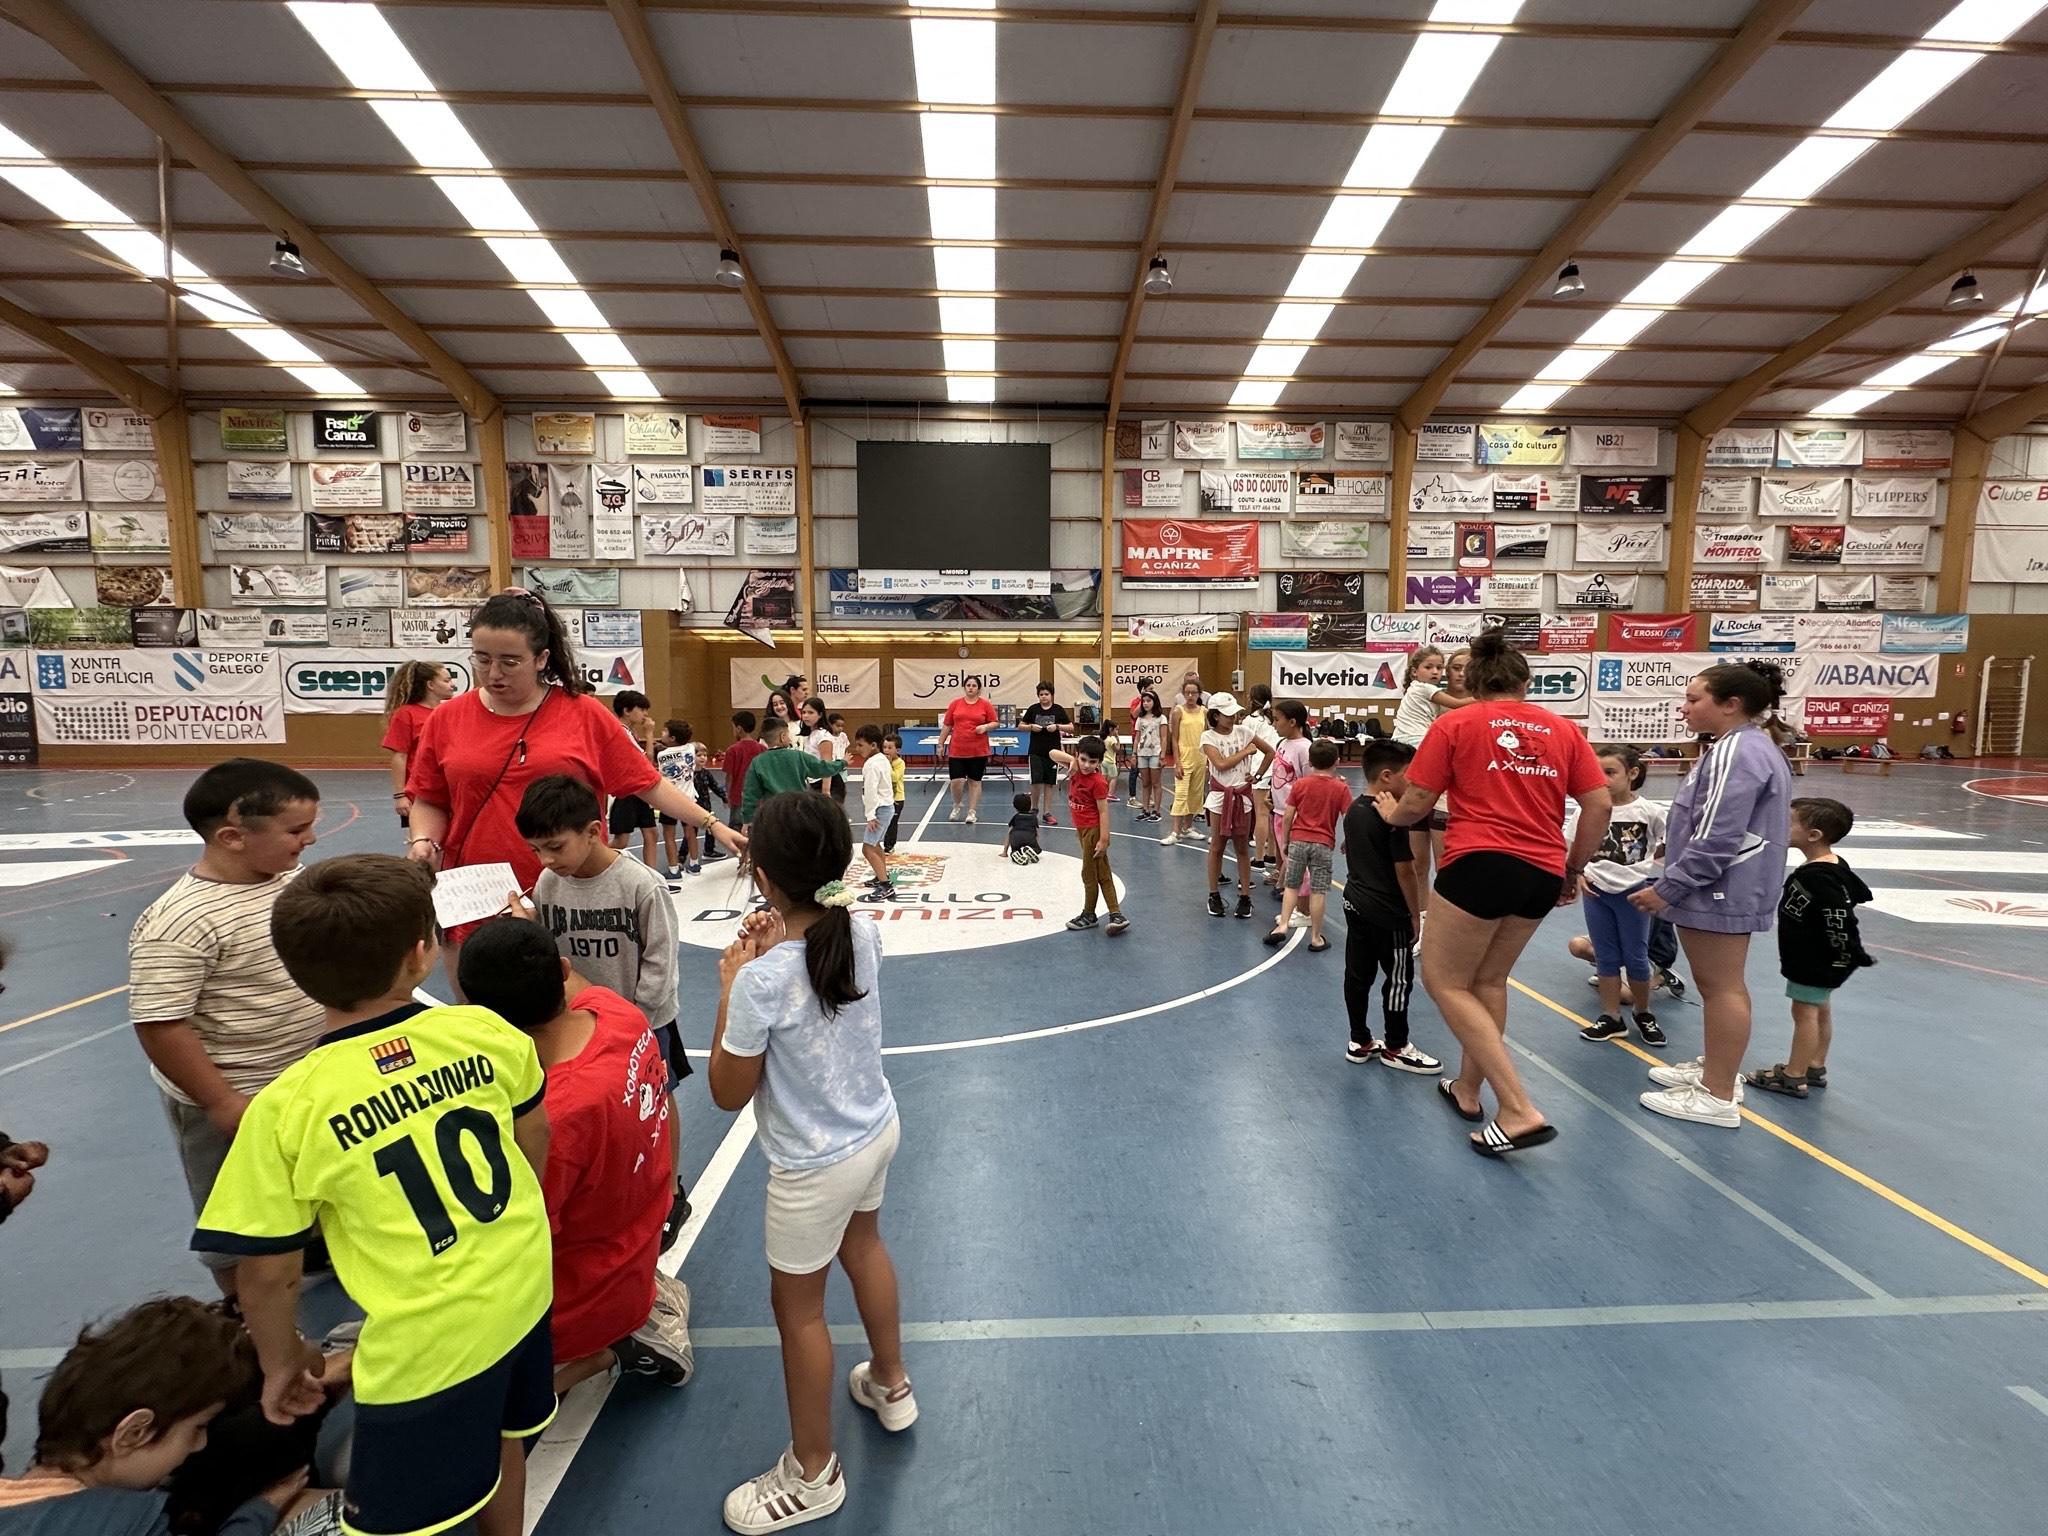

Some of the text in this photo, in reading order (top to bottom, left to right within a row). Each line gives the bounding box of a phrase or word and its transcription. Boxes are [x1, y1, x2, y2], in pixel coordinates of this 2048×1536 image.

[1489, 440, 1558, 450] casa da cultura
[1596, 434, 1625, 446] NB21
[405, 465, 471, 483] PEPA
[729, 469, 794, 480] SERFIS
[1233, 479, 1289, 494] OS DO COUTO
[1336, 480, 1384, 495] EL HOGAR
[1987, 485, 2033, 501] Clube
[1846, 541, 1925, 551] Gestoría Mera
[1127, 546, 1214, 561] MAPFRE
[1703, 547, 1762, 558] MONTERO
[1141, 560, 1201, 570] A CAÑIZA
[401, 620, 429, 631] KASTOR
[1148, 619, 1195, 632] ¡Gracias,
[1178, 624, 1216, 639] afición!
[1727, 620, 1762, 631] Rocha
[71, 657, 121, 669] XUNTA
[208, 653, 269, 664] DEPORTE
[208, 664, 264, 675] GALEGO
[1115, 664, 1169, 674] DEPORTE
[1628, 662, 1671, 673] XUNTA
[72, 672, 154, 684] DE GALICIA
[922, 669, 1001, 692] galia
[1115, 675, 1163, 685] GALO
[1279, 667, 1369, 686] helvetia
[1626, 675, 1642, 686] DE
[135, 701, 263, 722] DEPUTACIÓN
[1852, 702, 1890, 714] CAÑIZA
[136, 723, 268, 740] PONTEVEDRA
[1487, 760, 1499, 771] A
[848, 905, 1044, 921] AÑIZA
[568, 936, 619, 958] 1970
[329, 1054, 495, 1152] RONALDINHO
[373, 1105, 512, 1257] 10
